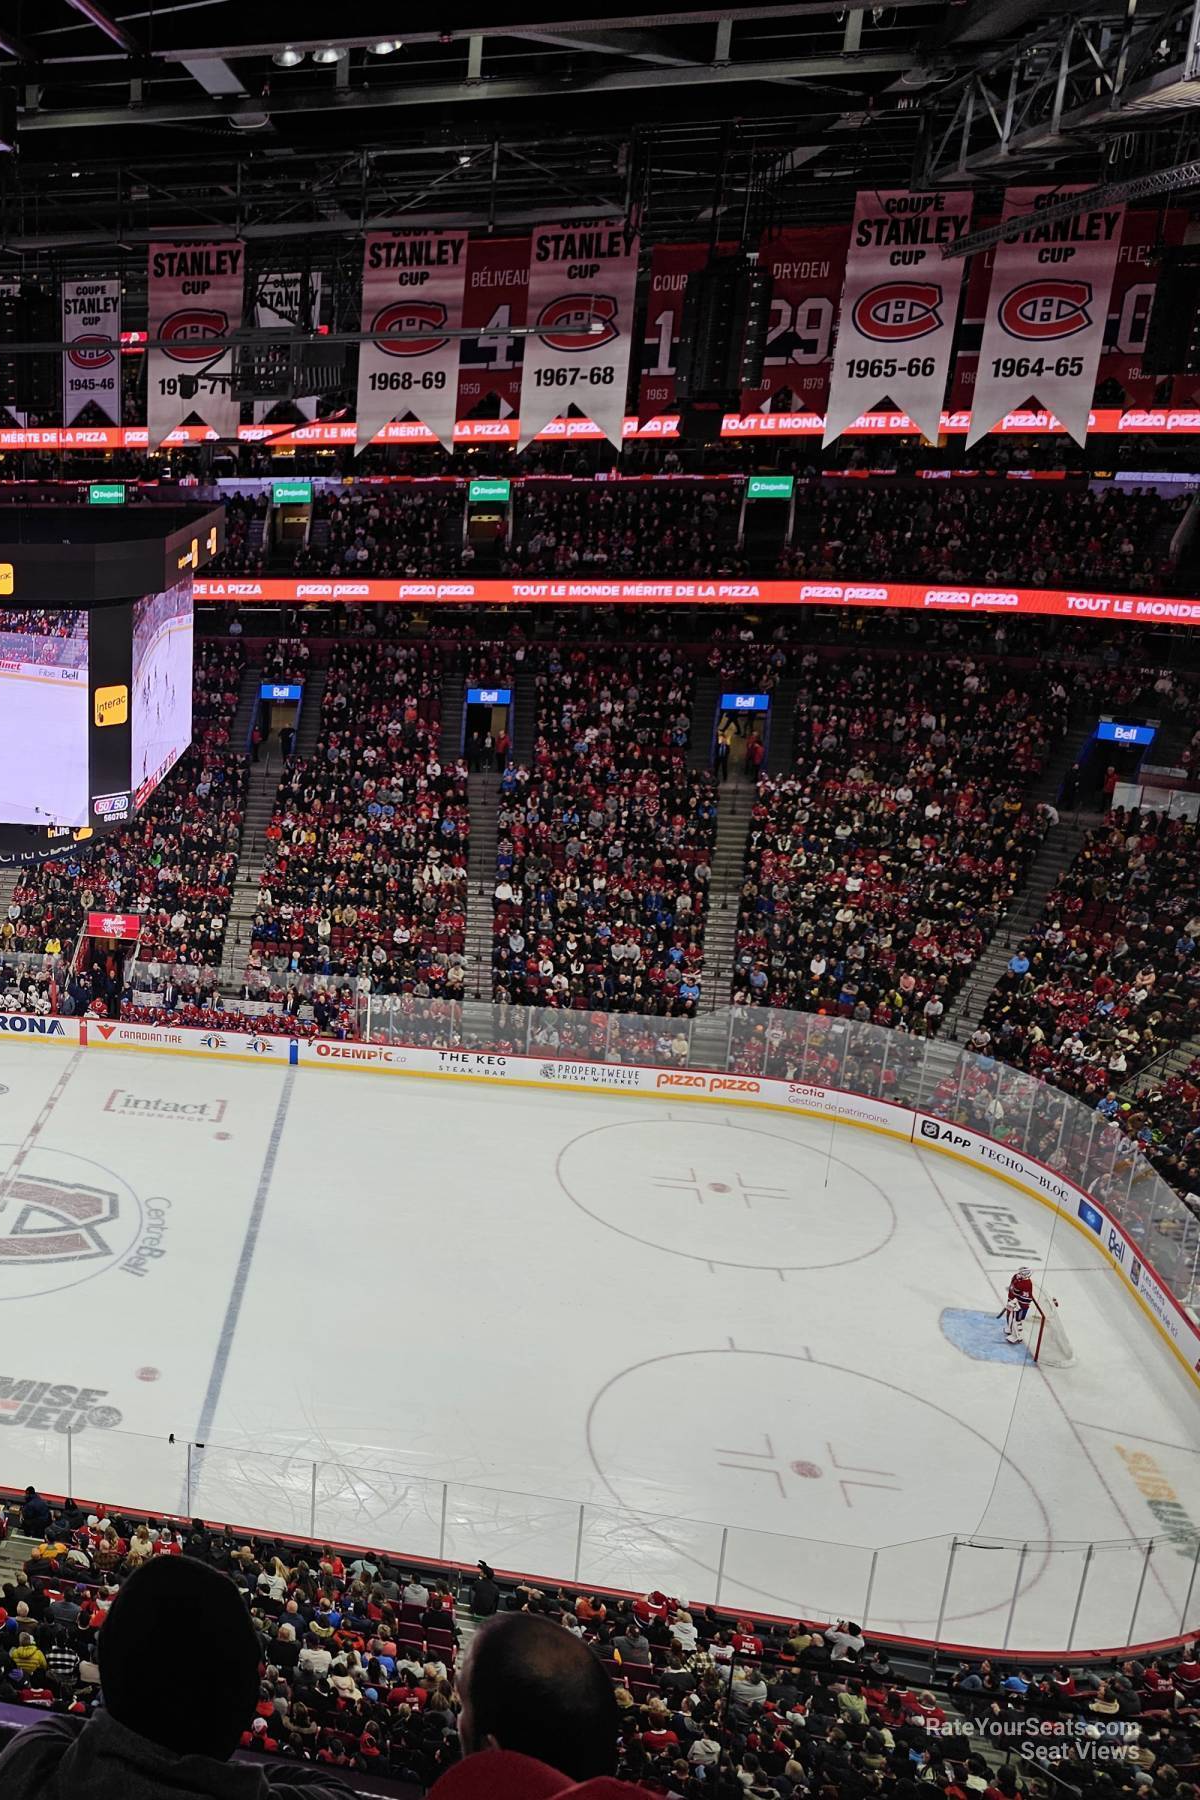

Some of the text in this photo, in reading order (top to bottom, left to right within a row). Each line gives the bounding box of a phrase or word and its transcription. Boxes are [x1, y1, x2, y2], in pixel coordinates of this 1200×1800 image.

[855, 216, 968, 247] STANLEY
[1003, 211, 1122, 245] STANLEY
[368, 238, 465, 269] STANLEY
[535, 230, 635, 262] STANLEY
[153, 250, 242, 278] STANLEY
[890, 249, 926, 266] CUP
[1038, 247, 1076, 264] CUP
[398, 271, 431, 286] CUP
[471, 268, 530, 289] BÉLIVEAU
[567, 264, 600, 280] CUP
[772, 261, 830, 280] DRYDEN
[76, 285, 107, 296] COUPE
[181, 280, 211, 296] CUP
[64, 297, 120, 316] STANLEY
[82, 315, 101, 327] CUP
[477, 304, 515, 371] 4
[534, 366, 615, 387] 1967-68
[845, 357, 936, 379] 1965-66
[992, 357, 1085, 379] 1964-65
[68, 377, 115, 392] 1945-46
[368, 370, 447, 392] 1968-69
[454, 424, 472, 436] LA
[473, 423, 511, 436] PIZZA
[760, 415, 776, 430] LE
[889, 415, 910, 428] DE
[1118, 413, 1166, 430] pizza
[42, 432, 58, 443] DE
[60, 432, 74, 443] LA
[76, 431, 108, 443] PIZZA
[323, 426, 339, 439] LE
[192, 583, 263, 596] DE LA PIZZA
[296, 584, 370, 598] pizza pizza
[399, 584, 475, 599] pizza pizza
[512, 582, 760, 598] TOUT LE MONDE MÉRITE DE LA PIZZA
[800, 585, 889, 602] pizza pizza
[924, 589, 1019, 608] pizza pizza
[1067, 596, 1111, 613] TOUT
[1113, 598, 1134, 615] LE
[61, 669, 79, 681] Bell
[272, 687, 289, 698] Bell
[480, 691, 498, 703] Bell
[96, 694, 127, 713] Interac
[735, 696, 755, 708] Bell
[1114, 727, 1138, 741] Bell
[119, 1030, 182, 1044] CANADIAN TIRE
[439, 1052, 507, 1066] THE KEG
[592, 1076, 640, 1085] WHISKEY
[656, 1072, 761, 1094] pizza pizza
[788, 1084, 826, 1099] Scotia
[120, 1094, 211, 1116] intact
[788, 1095, 823, 1110] Gestion
[824, 1102, 838, 1112] de
[1107, 1228, 1126, 1264] Bell
